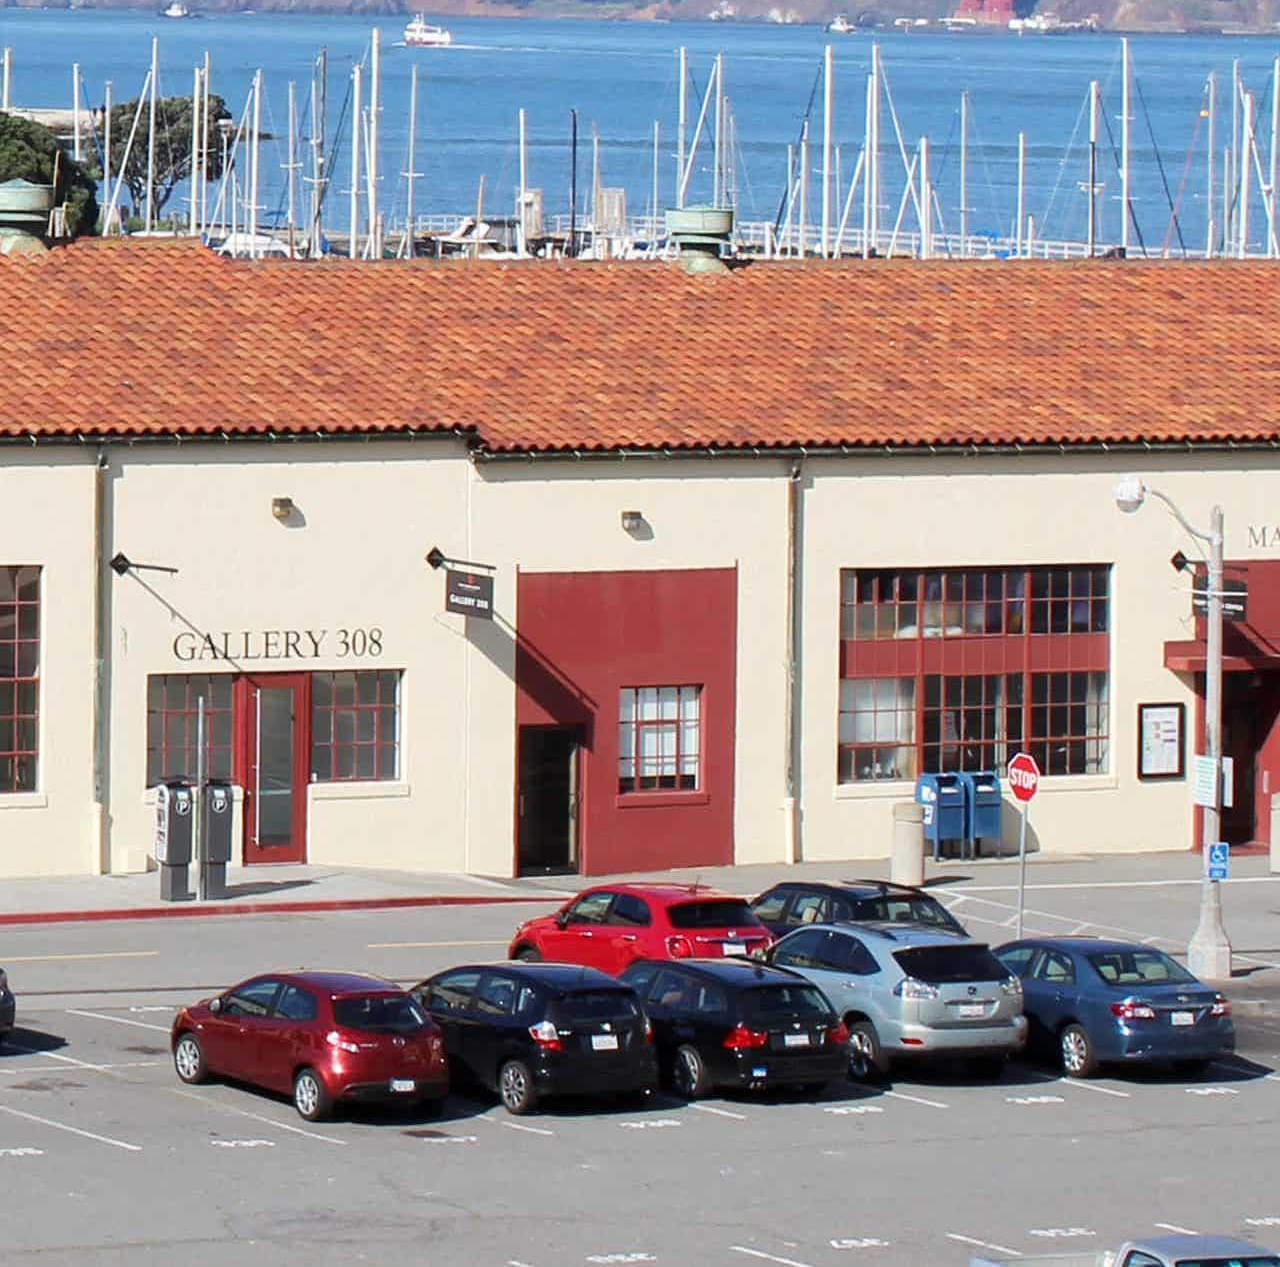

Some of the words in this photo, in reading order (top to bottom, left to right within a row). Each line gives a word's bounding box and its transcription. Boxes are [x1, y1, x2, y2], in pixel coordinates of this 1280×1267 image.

[173, 630, 327, 661] GALLERY
[336, 628, 383, 658] 308
[1010, 768, 1037, 790] STOP
